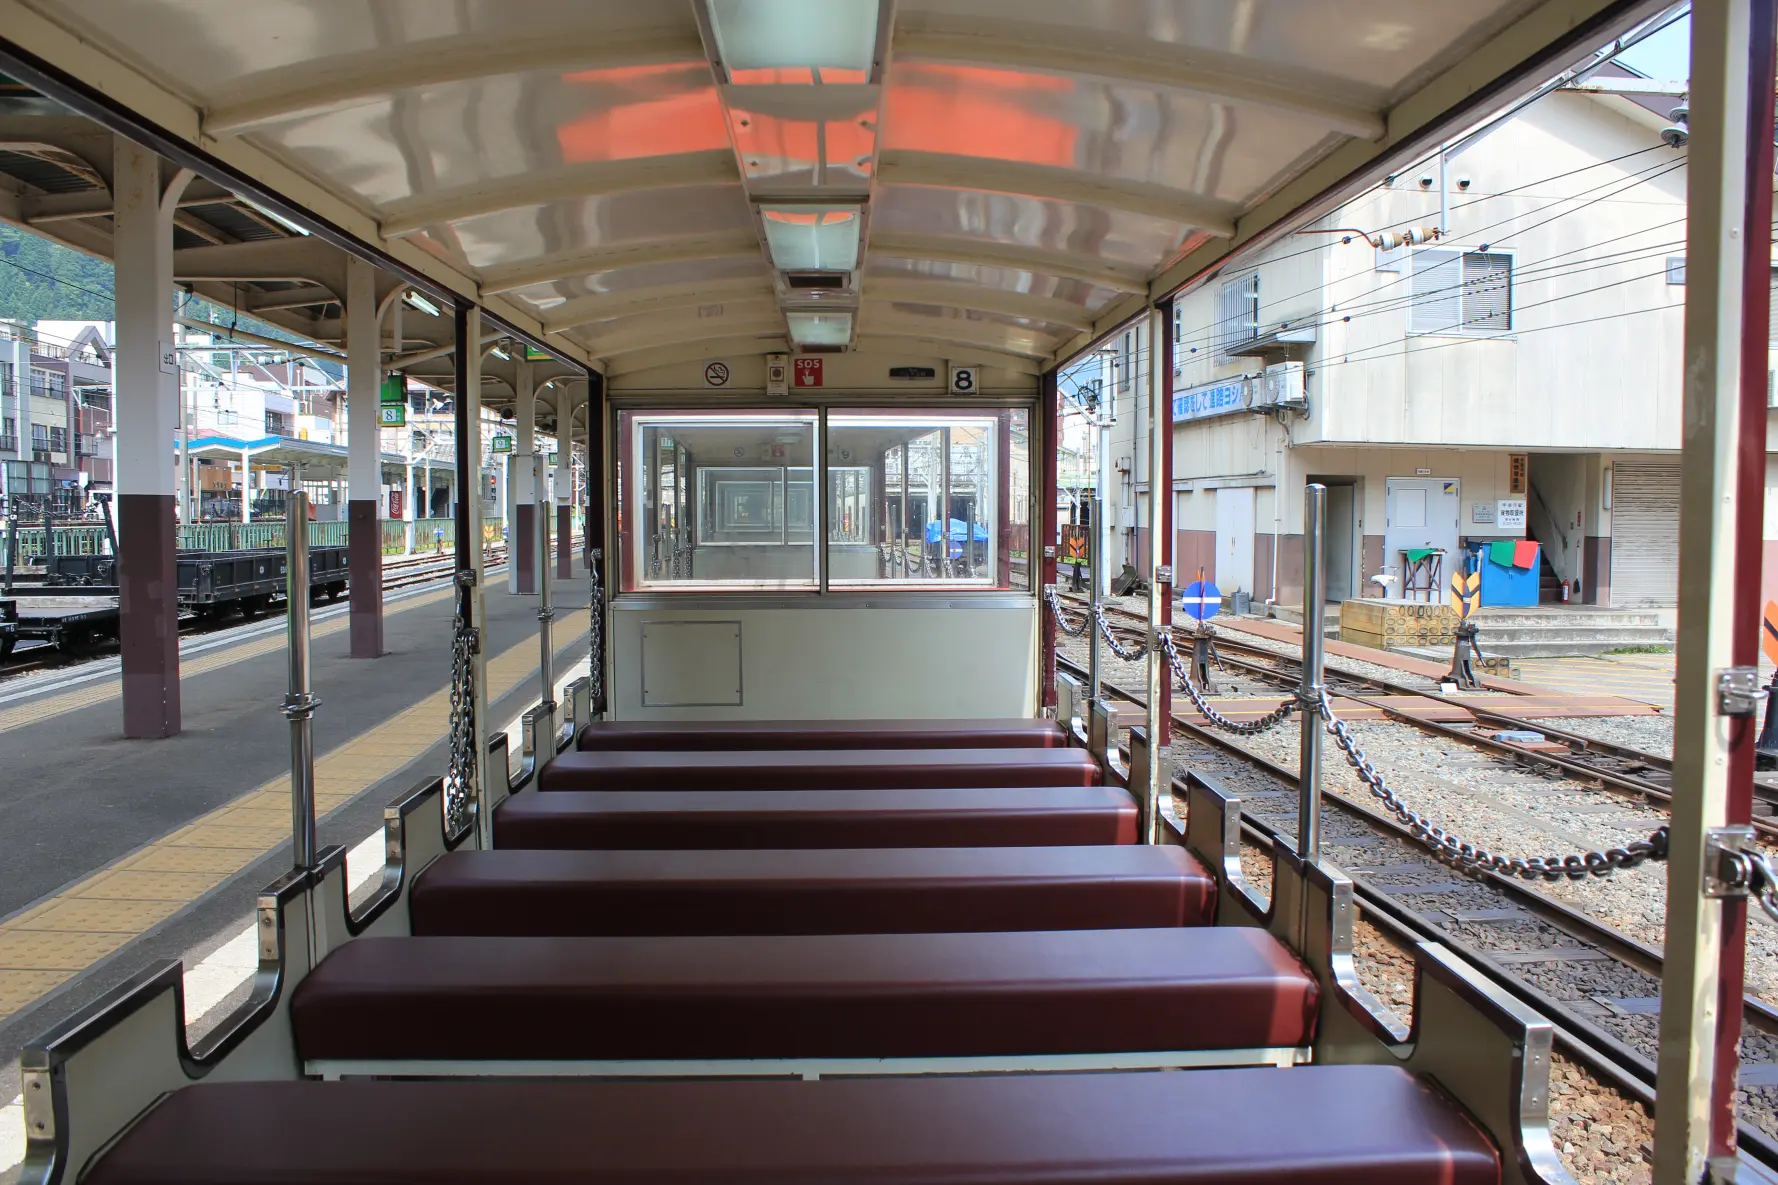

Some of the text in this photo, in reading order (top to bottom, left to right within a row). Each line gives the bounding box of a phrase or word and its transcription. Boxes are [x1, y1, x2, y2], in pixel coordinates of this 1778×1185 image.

[164, 353, 173, 365] 出口
[797, 359, 820, 369] SOS
[954, 369, 973, 391] 8
[385, 409, 393, 421] 8
[841, 450, 850, 459] 9
[391, 492, 400, 515] Coca-Cola
